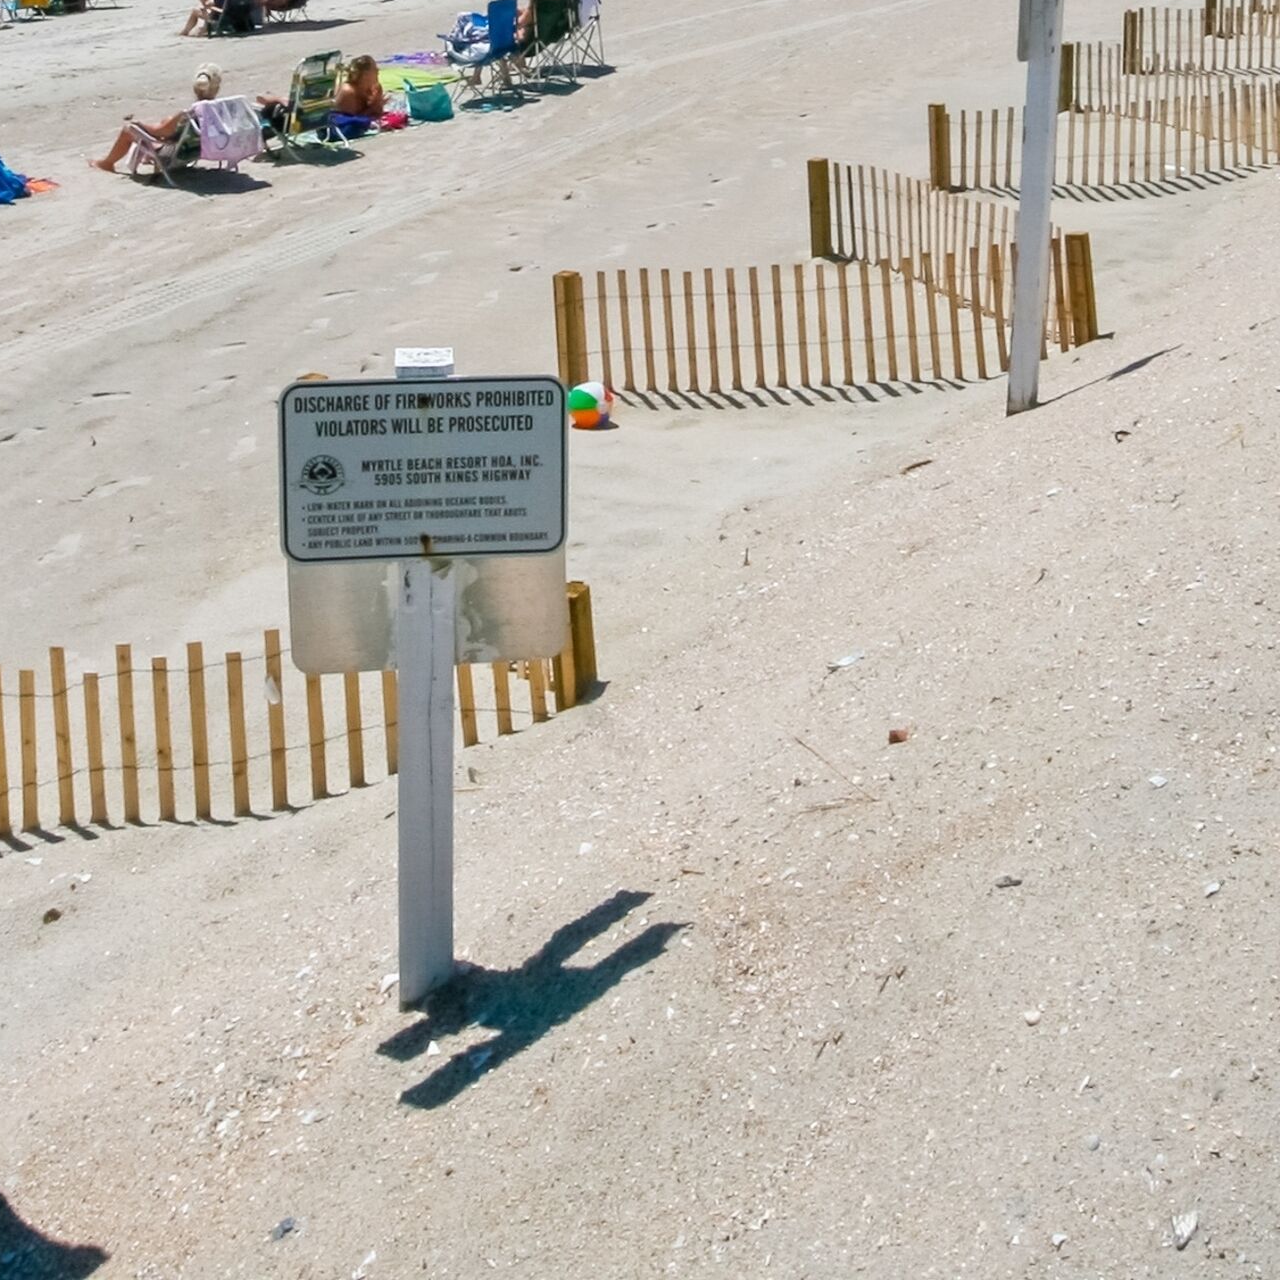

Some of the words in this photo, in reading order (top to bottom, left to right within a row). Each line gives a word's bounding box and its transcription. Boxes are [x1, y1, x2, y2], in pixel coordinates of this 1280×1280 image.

[294, 394, 370, 414] DISCHARGE
[375, 393, 390, 411] OF
[476, 390, 554, 408] PROHIBITED
[315, 418, 387, 437] VIOLATORS
[391, 418, 422, 434] WILL
[428, 417, 443, 433] BE
[448, 415, 534, 433] PROSECUTED
[361, 459, 402, 472] MYRTLE
[407, 458, 442, 471] BEACH
[446, 456, 488, 469] RESORT
[521, 455, 543, 467] INC.
[374, 472, 402, 486] 5905
[406, 471, 441, 484] SOUTH
[445, 470, 478, 483] KINGS
[482, 469, 532, 481] HIGHWAY
